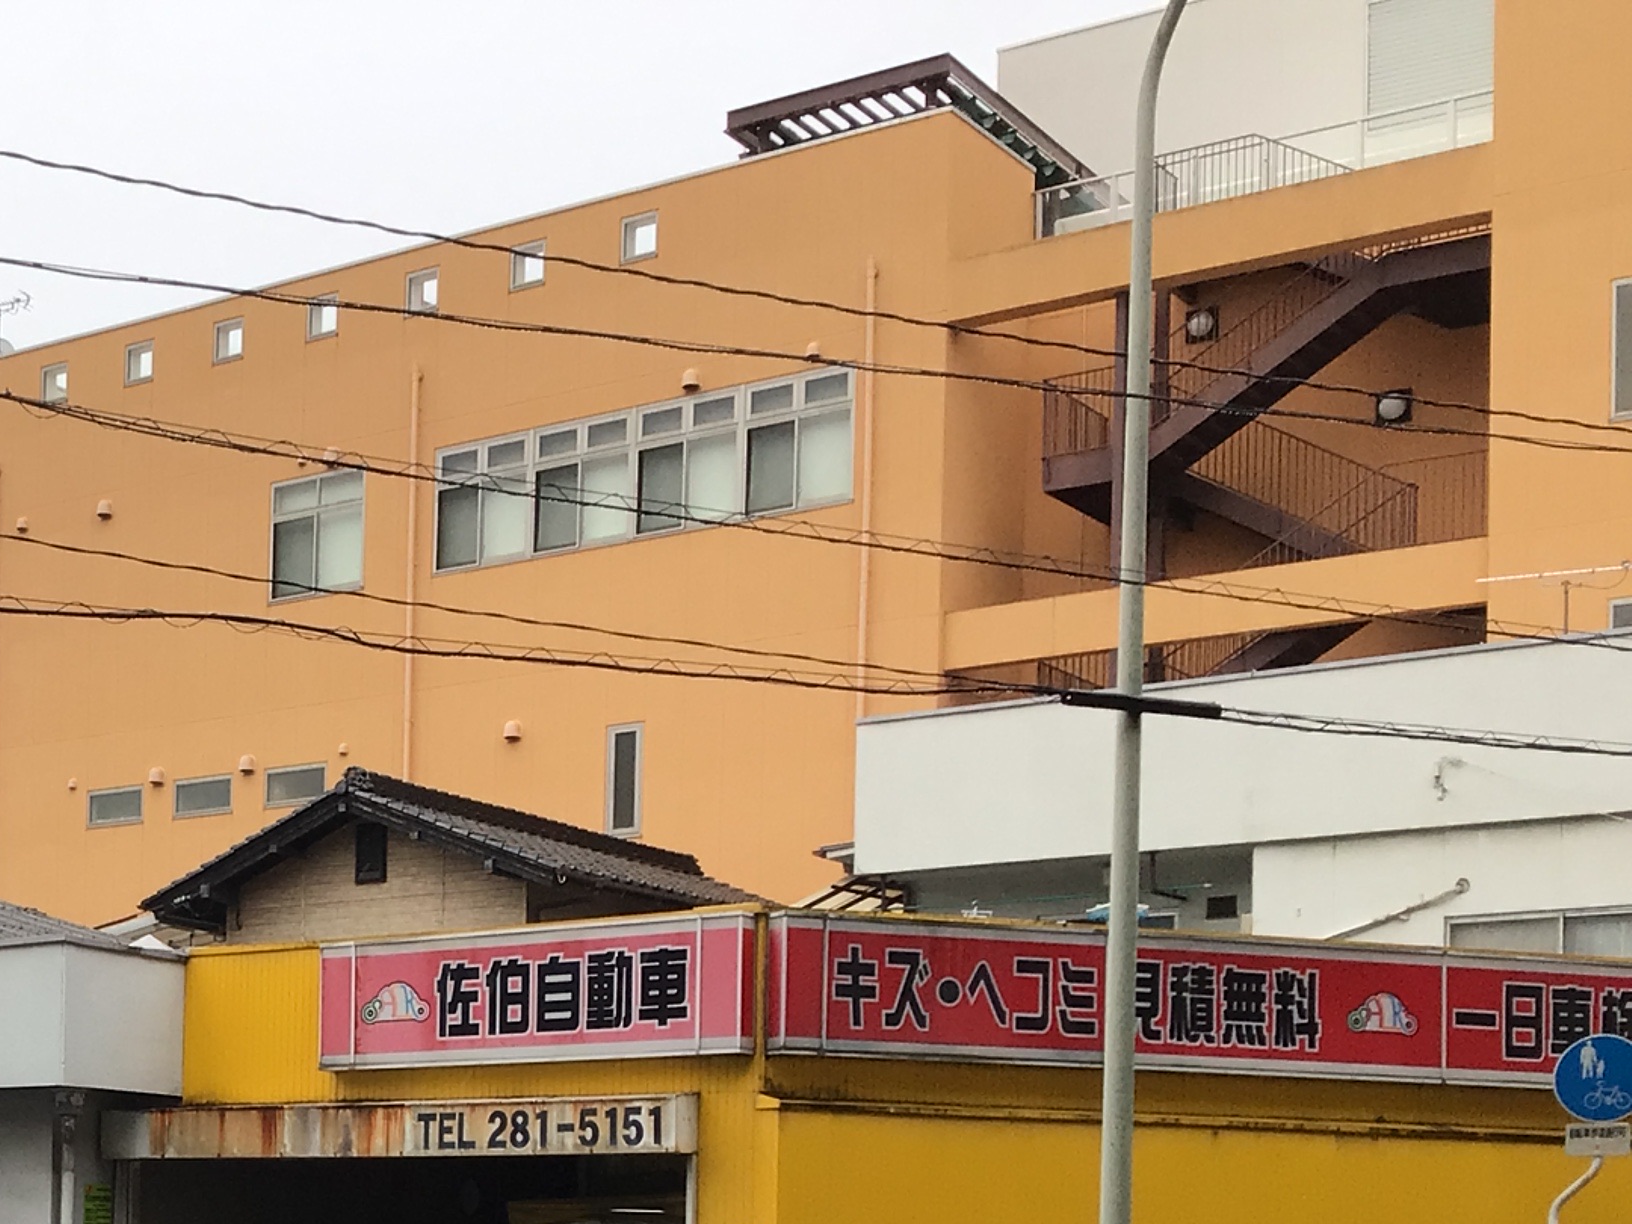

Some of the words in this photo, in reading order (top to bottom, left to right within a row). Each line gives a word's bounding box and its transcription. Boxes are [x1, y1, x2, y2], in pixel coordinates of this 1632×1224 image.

[437, 945, 691, 1040] 佐伯自動車
[417, 1112, 475, 1150] TEL
[487, 1105, 663, 1150] 281-5151
